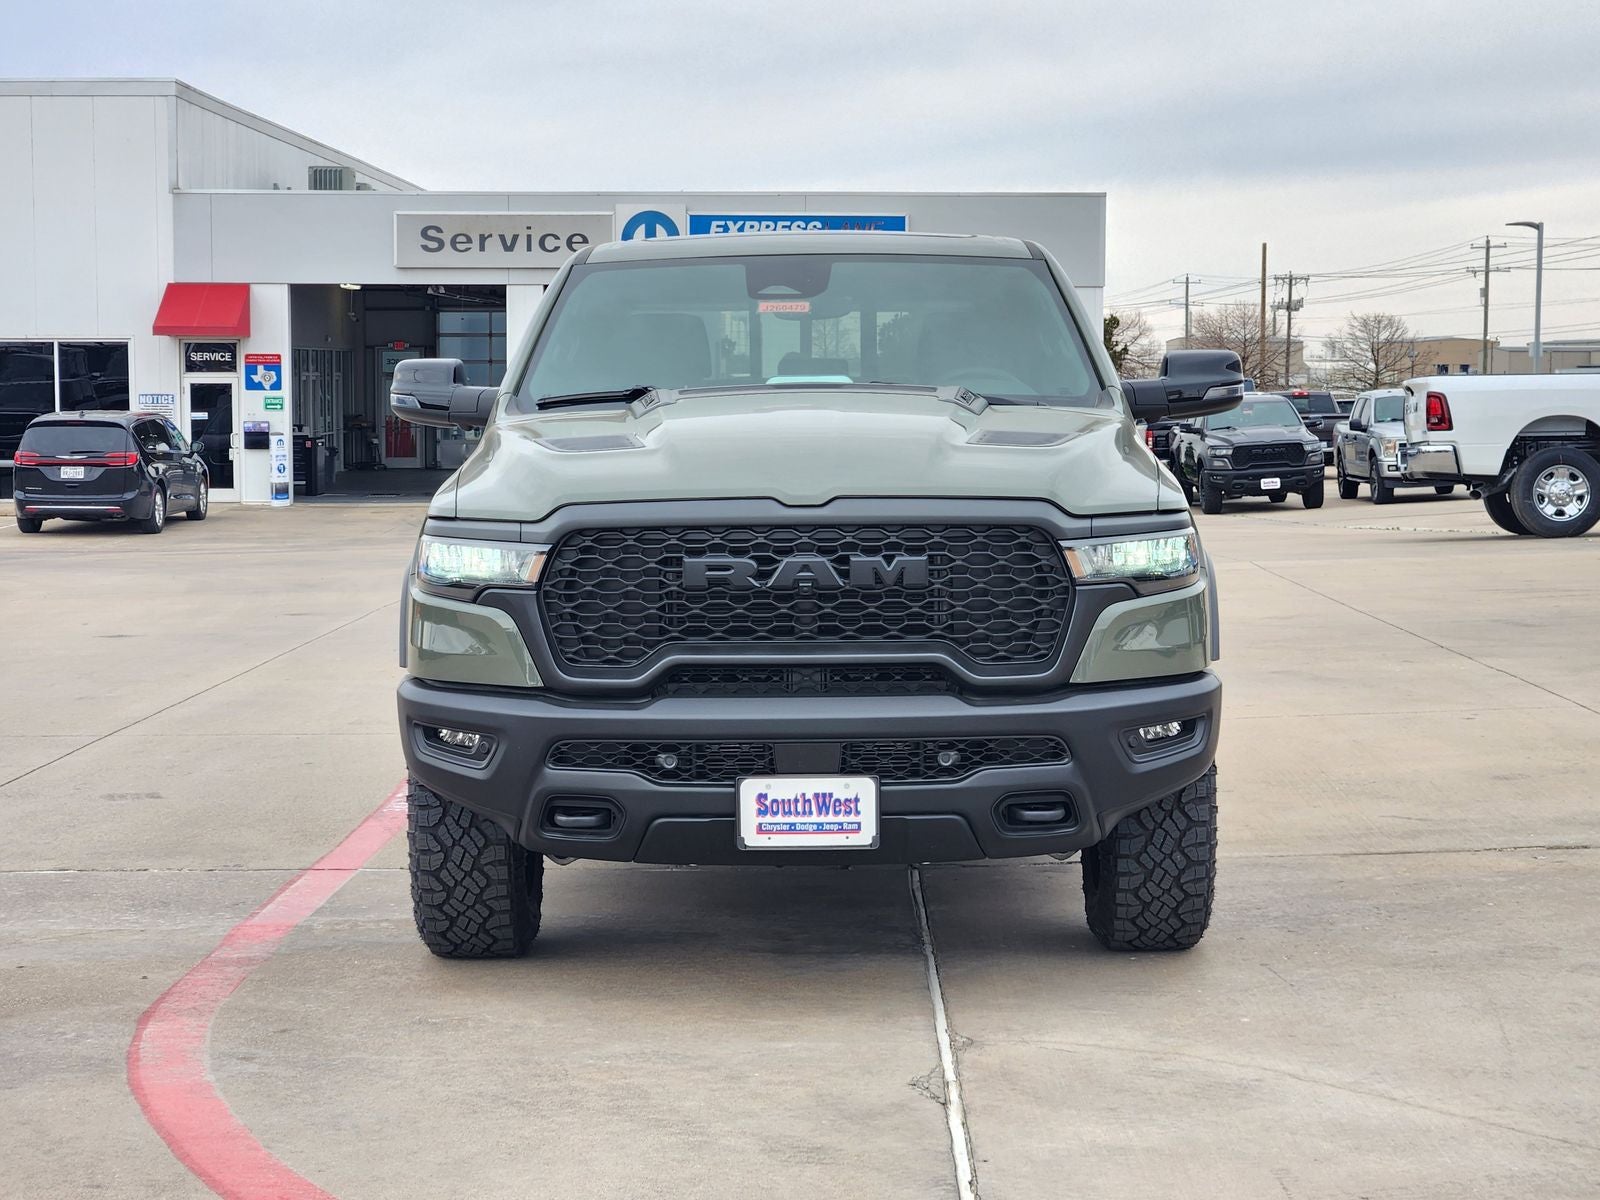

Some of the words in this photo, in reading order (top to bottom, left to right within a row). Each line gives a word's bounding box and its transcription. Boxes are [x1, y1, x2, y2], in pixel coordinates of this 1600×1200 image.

[420, 225, 589, 253] Service
[190, 352, 232, 361] SERVICE
[140, 394, 174, 404] NOTICE
[682, 556, 929, 588] RAM
[756, 792, 861, 817] SouthWest
[761, 823, 790, 831] Chrysler
[796, 823, 817, 831] Dodge
[822, 822, 838, 831] Jeep
[843, 822, 858, 830] Ram
